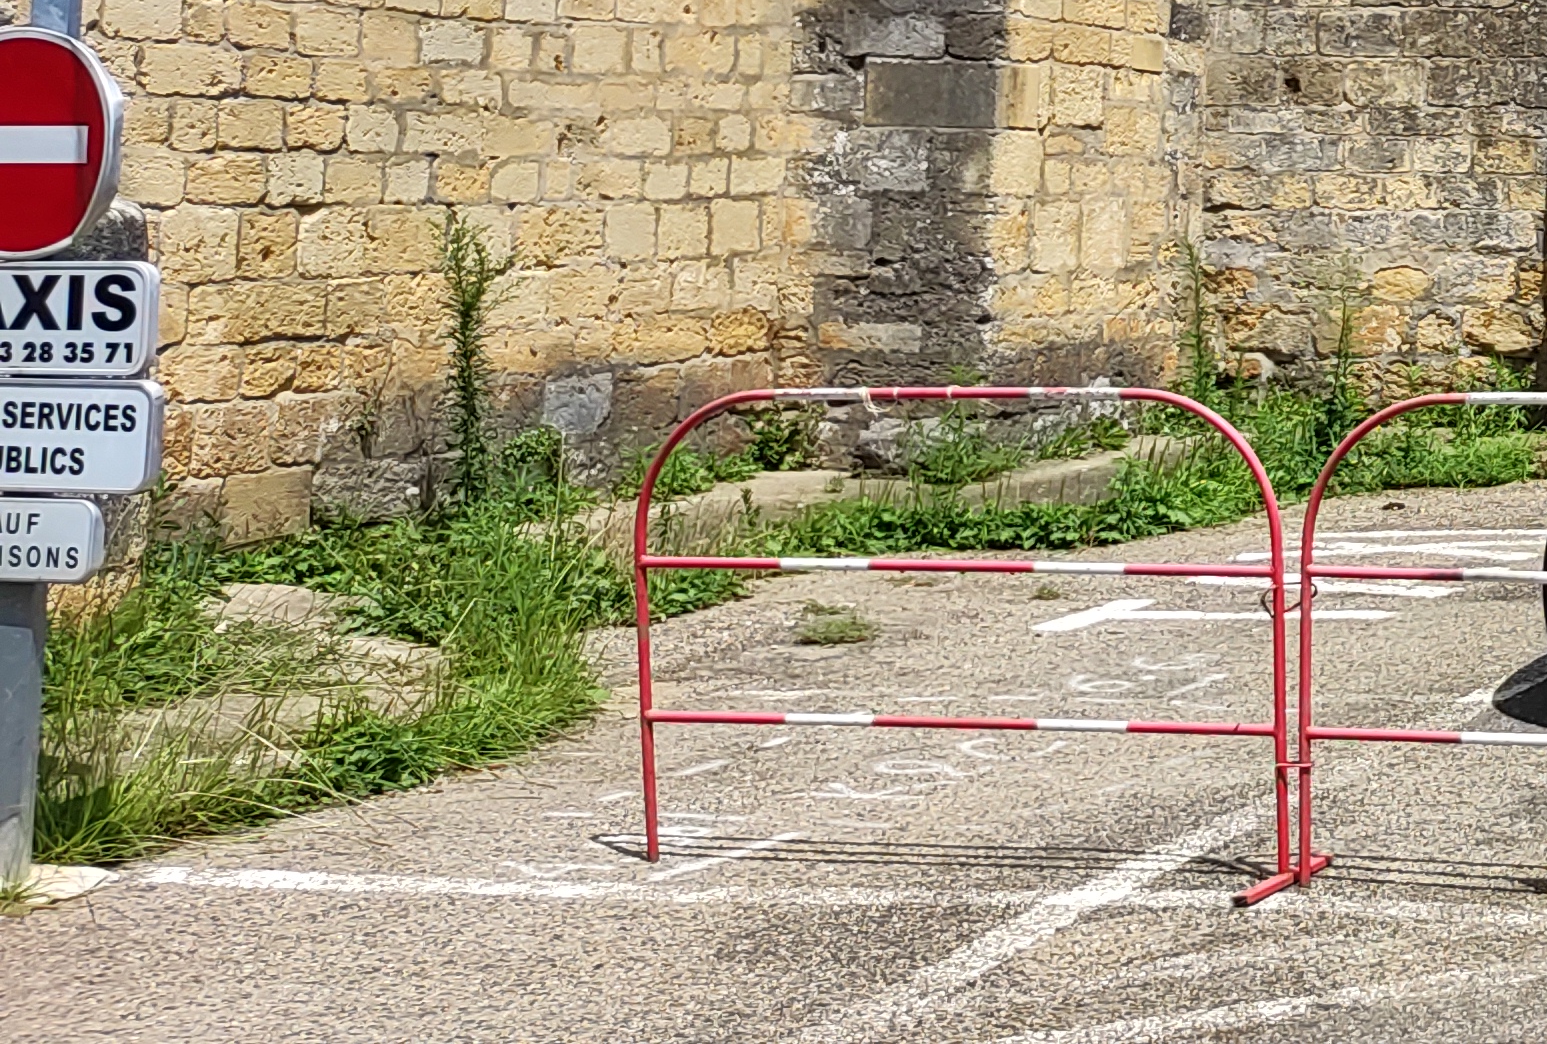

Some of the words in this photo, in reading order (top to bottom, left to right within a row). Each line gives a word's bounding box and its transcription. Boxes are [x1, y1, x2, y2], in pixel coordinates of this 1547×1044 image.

[0, 273, 137, 332] XIS
[21, 341, 54, 363] 28
[63, 341, 95, 364] 35
[105, 342, 134, 364] 71
[2, 401, 137, 433] SERVICES
[0, 445, 85, 476] BLICS
[0, 512, 41, 535] UF
